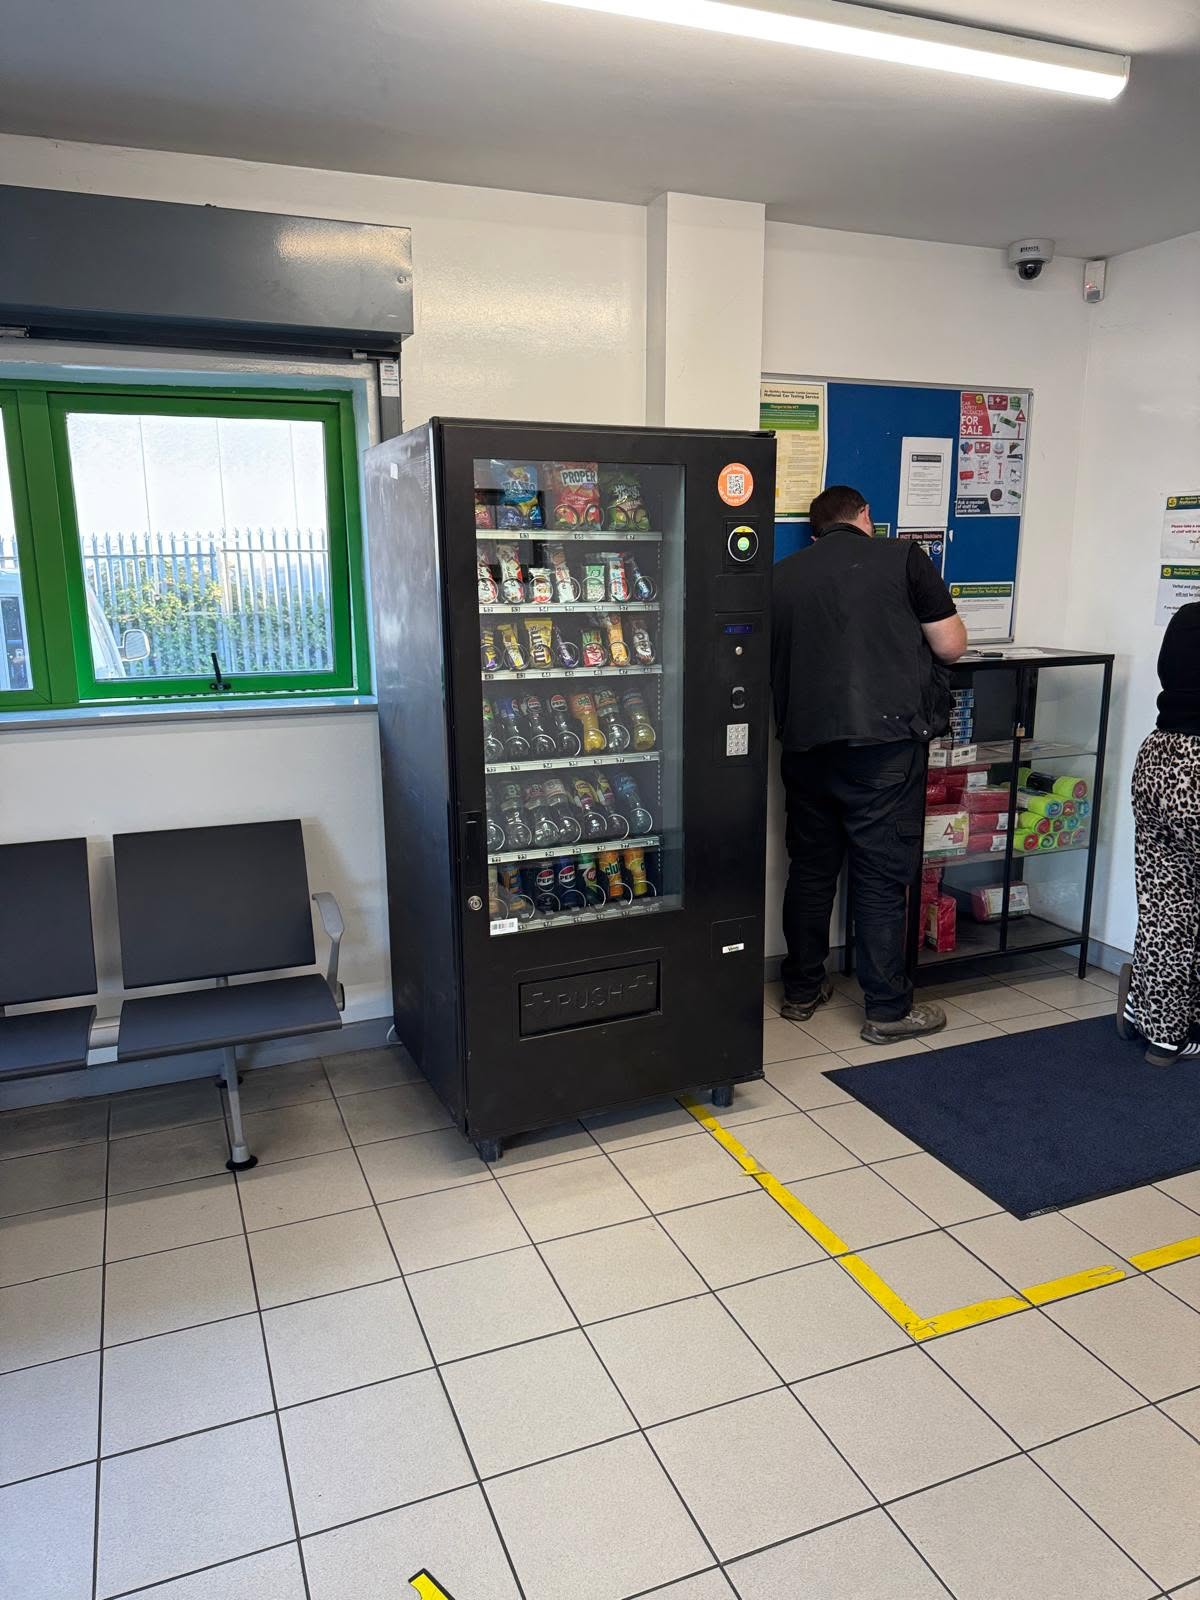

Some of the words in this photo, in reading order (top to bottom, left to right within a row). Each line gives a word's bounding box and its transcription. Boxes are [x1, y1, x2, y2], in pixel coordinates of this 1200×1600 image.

[961, 416, 979, 425] FOR
[961, 425, 983, 435] SALE
[562, 469, 596, 484] PROPER
[557, 983, 623, 1012] PUSH
